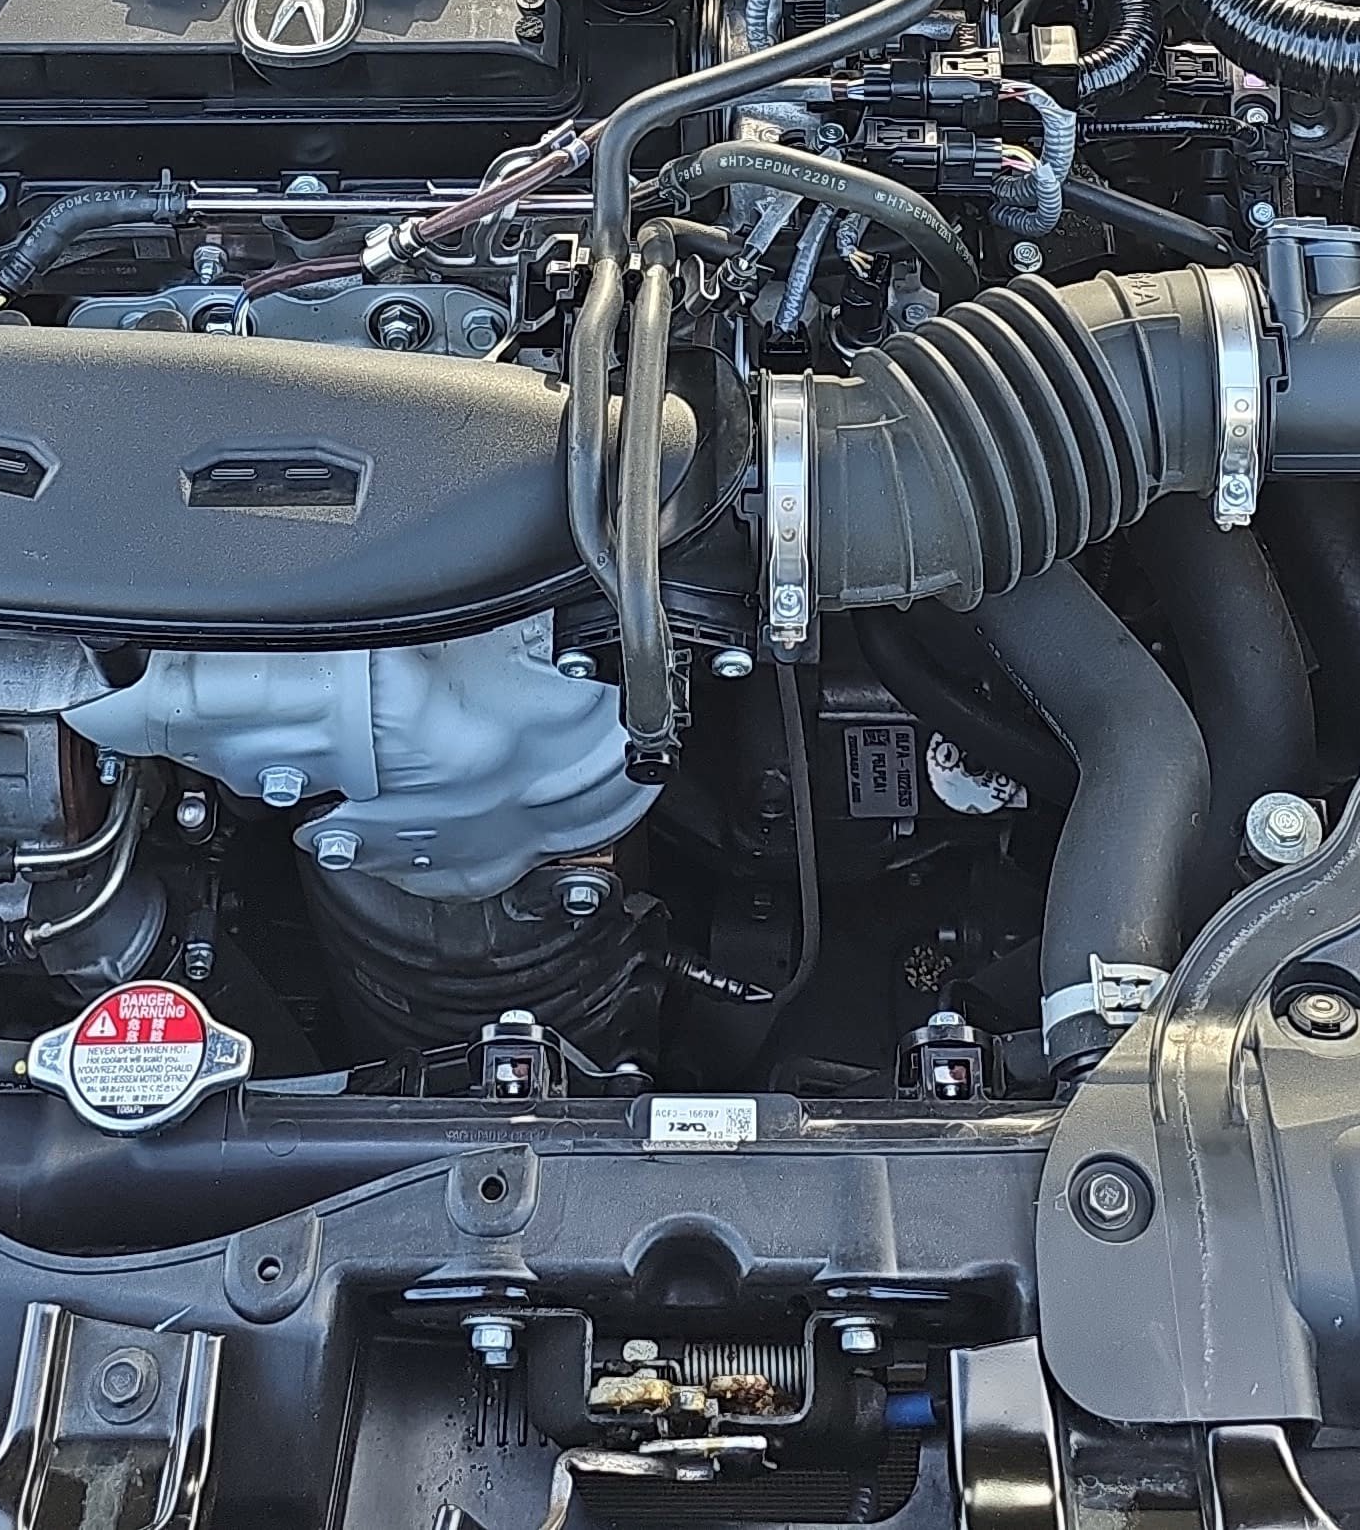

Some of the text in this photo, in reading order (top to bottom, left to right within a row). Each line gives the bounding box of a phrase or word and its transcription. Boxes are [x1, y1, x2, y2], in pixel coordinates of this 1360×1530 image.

[120, 993, 174, 1006] DANGER
[119, 1005, 186, 1019] WARNUNG
[88, 1047, 116, 1055] NEVER
[119, 1046, 141, 1054] OPEN
[143, 1046, 168, 1054] WHEN
[87, 1056, 100, 1064] Hot
[101, 1056, 128, 1064] coolant
[136, 1065, 164, 1073] QUAND
